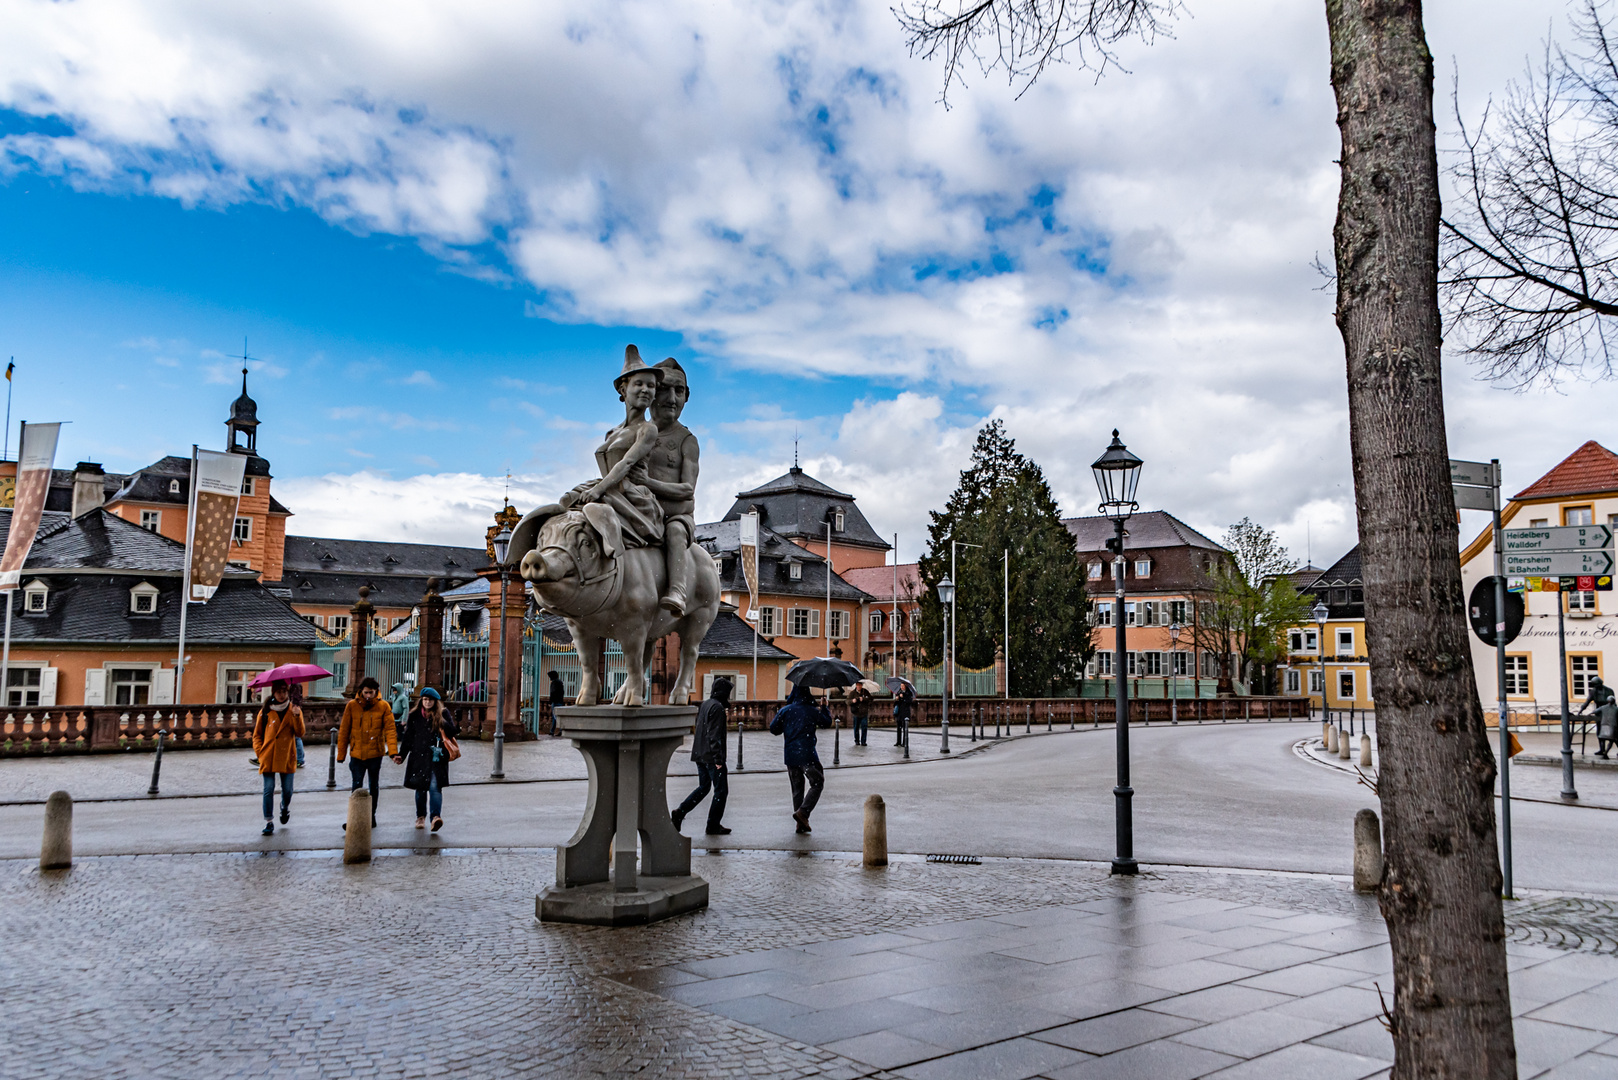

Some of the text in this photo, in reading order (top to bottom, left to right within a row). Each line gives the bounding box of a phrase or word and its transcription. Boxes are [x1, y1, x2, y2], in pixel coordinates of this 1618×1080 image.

[1506, 531, 1550, 540] Heidelberg
[1507, 540, 1541, 549] Walldorf
[1507, 556, 1552, 564] Oftersheim
[1516, 565, 1550, 573] Bahnhof
